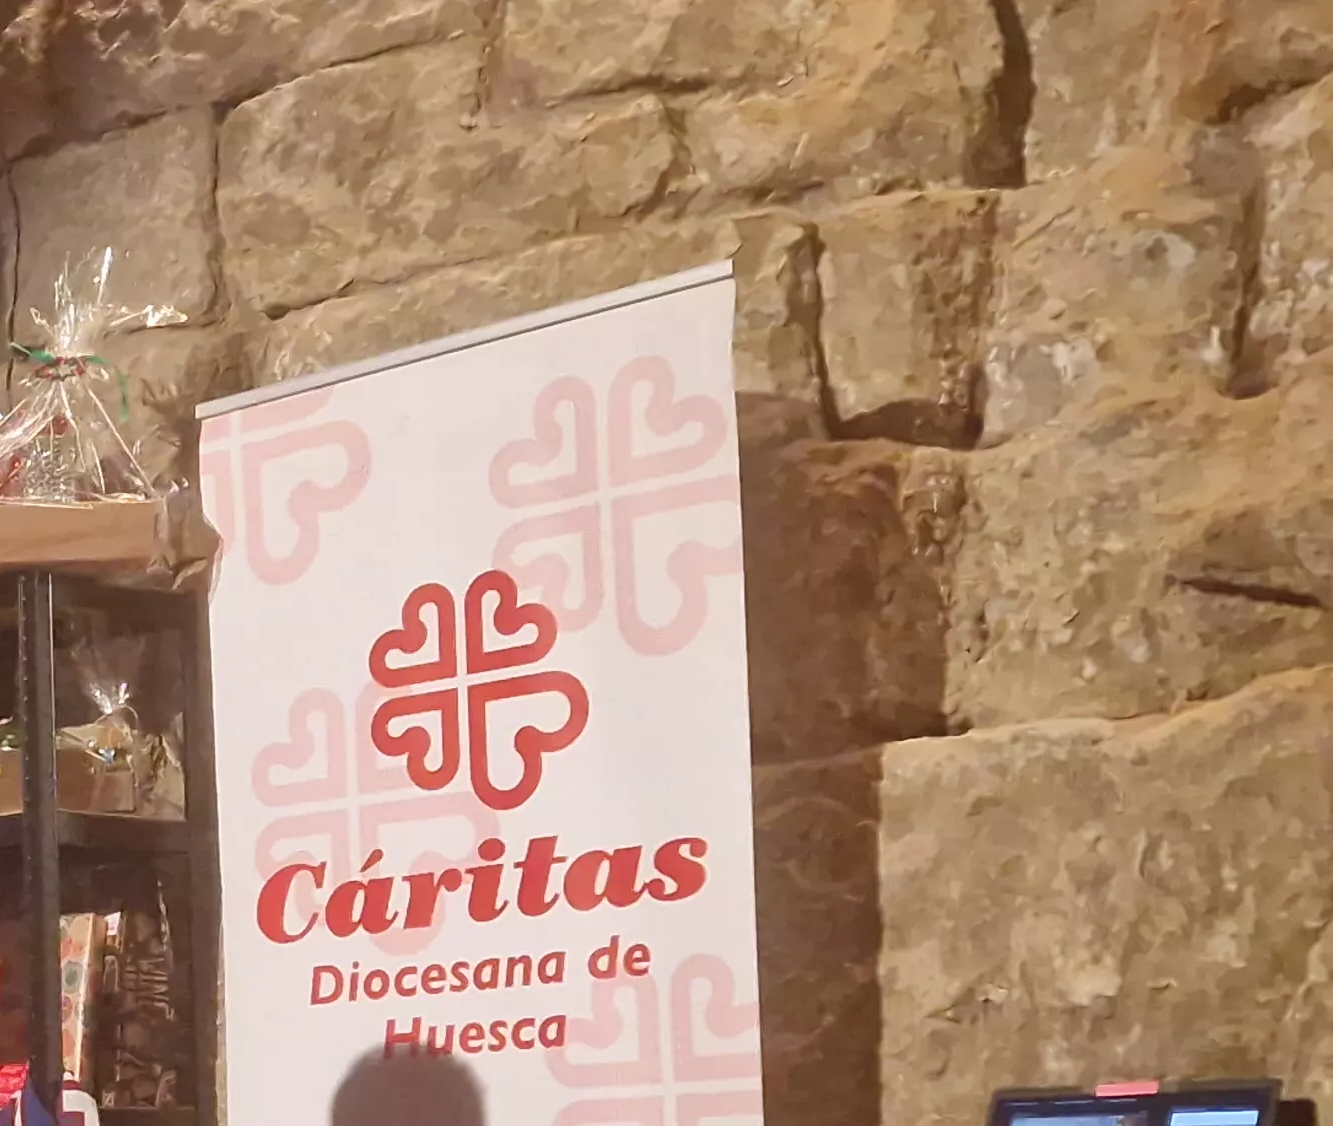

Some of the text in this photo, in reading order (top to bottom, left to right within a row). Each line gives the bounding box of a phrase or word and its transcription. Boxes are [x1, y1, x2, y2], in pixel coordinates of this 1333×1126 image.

[256, 834, 708, 944] Cáritas
[310, 934, 652, 1006] Diocesana de
[384, 1013, 568, 1061] Huesca
